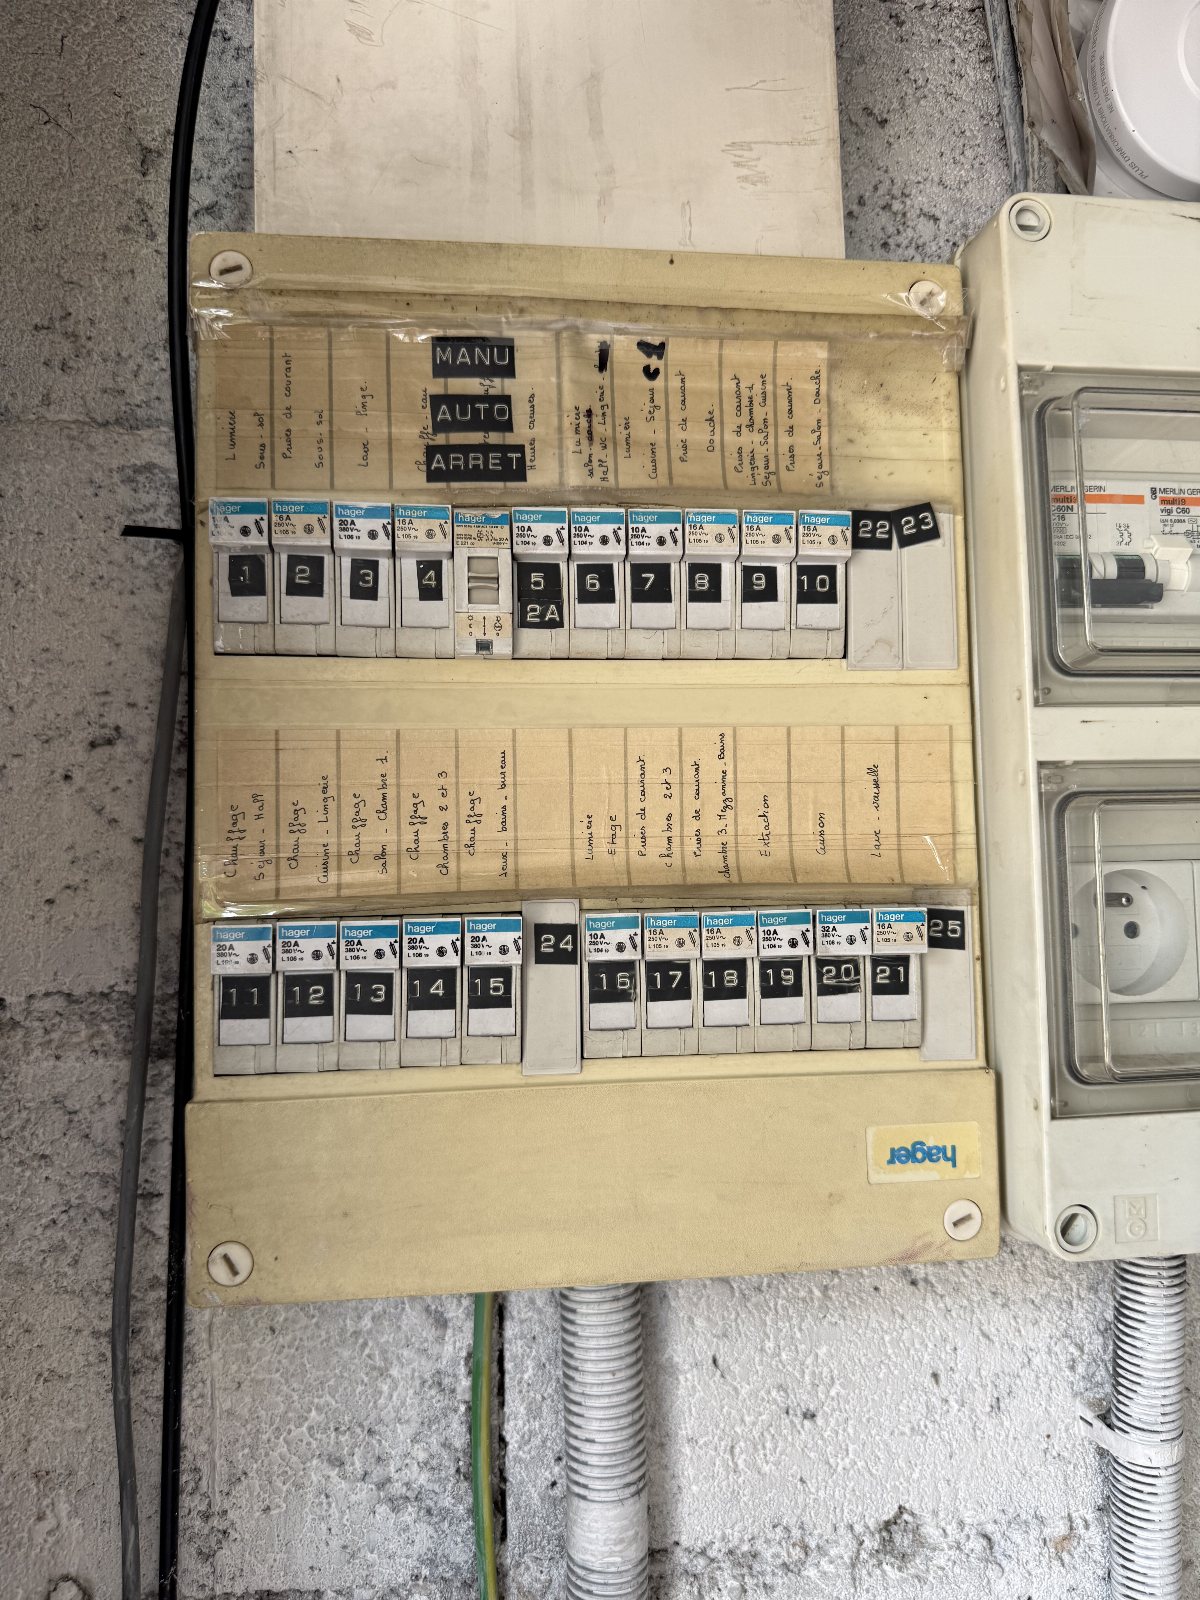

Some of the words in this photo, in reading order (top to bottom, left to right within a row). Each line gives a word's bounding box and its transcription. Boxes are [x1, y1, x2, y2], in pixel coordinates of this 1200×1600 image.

[436, 347, 510, 366] MANU
[283, 352, 292, 398] courant
[675, 370, 686, 411] courant
[282, 405, 292, 419] de
[437, 404, 510, 422] AUTO
[678, 417, 687, 432] de
[732, 424, 742, 437] de
[784, 425, 793, 437] de
[431, 452, 521, 471] ARRET
[1158, 487, 1186, 495] MERLIN
[275, 503, 305, 513] hager
[338, 506, 366, 516] hager
[399, 508, 427, 518] hager
[1160, 507, 1173, 515] vigi
[515, 512, 543, 522] hager
[574, 514, 601, 523] hager
[632, 513, 658, 523] hager
[689, 514, 716, 523] hager
[746, 515, 773, 524] hager
[803, 515, 830, 524] hager
[900, 512, 934, 536] 23
[858, 520, 890, 539] 22
[240, 565, 250, 584] 1
[295, 565, 311, 584] 2
[359, 569, 373, 587] 3
[421, 570, 437, 588] 4
[530, 573, 545, 590] 5
[585, 573, 601, 592] 6
[641, 573, 655, 591] 7
[694, 573, 709, 591] 8
[752, 573, 765, 591] 9
[800, 575, 830, 592] 10
[438, 770, 448, 779] 3
[662, 766, 672, 775] 3
[438, 785, 447, 798] et
[438, 804, 448, 812] 2
[636, 807, 645, 820] de
[692, 809, 700, 821] de
[756, 795, 771, 857] Extraction
[589, 920, 616, 929] hager
[650, 917, 677, 927] hager
[706, 916, 734, 926] hager
[761, 915, 787, 925] hager
[821, 914, 846, 923] hager
[878, 912, 905, 922] hager
[281, 927, 311, 938] hager
[344, 928, 373, 938] hager
[407, 923, 436, 934] hager
[469, 921, 497, 931] hager
[929, 919, 962, 938] 25
[216, 930, 245, 940] hager
[540, 934, 573, 953] 24
[599, 972, 630, 990] 16
[654, 971, 682, 989] 17
[708, 970, 738, 988] 18
[766, 968, 794, 986] 19
[822, 964, 855, 984] 20
[876, 966, 905, 984] 21
[292, 985, 325, 1005] 12
[354, 983, 386, 1003] 13
[413, 979, 445, 997] 14
[474, 978, 504, 996] 15
[229, 988, 258, 1006] 11
[886, 1140, 957, 1168] hager
